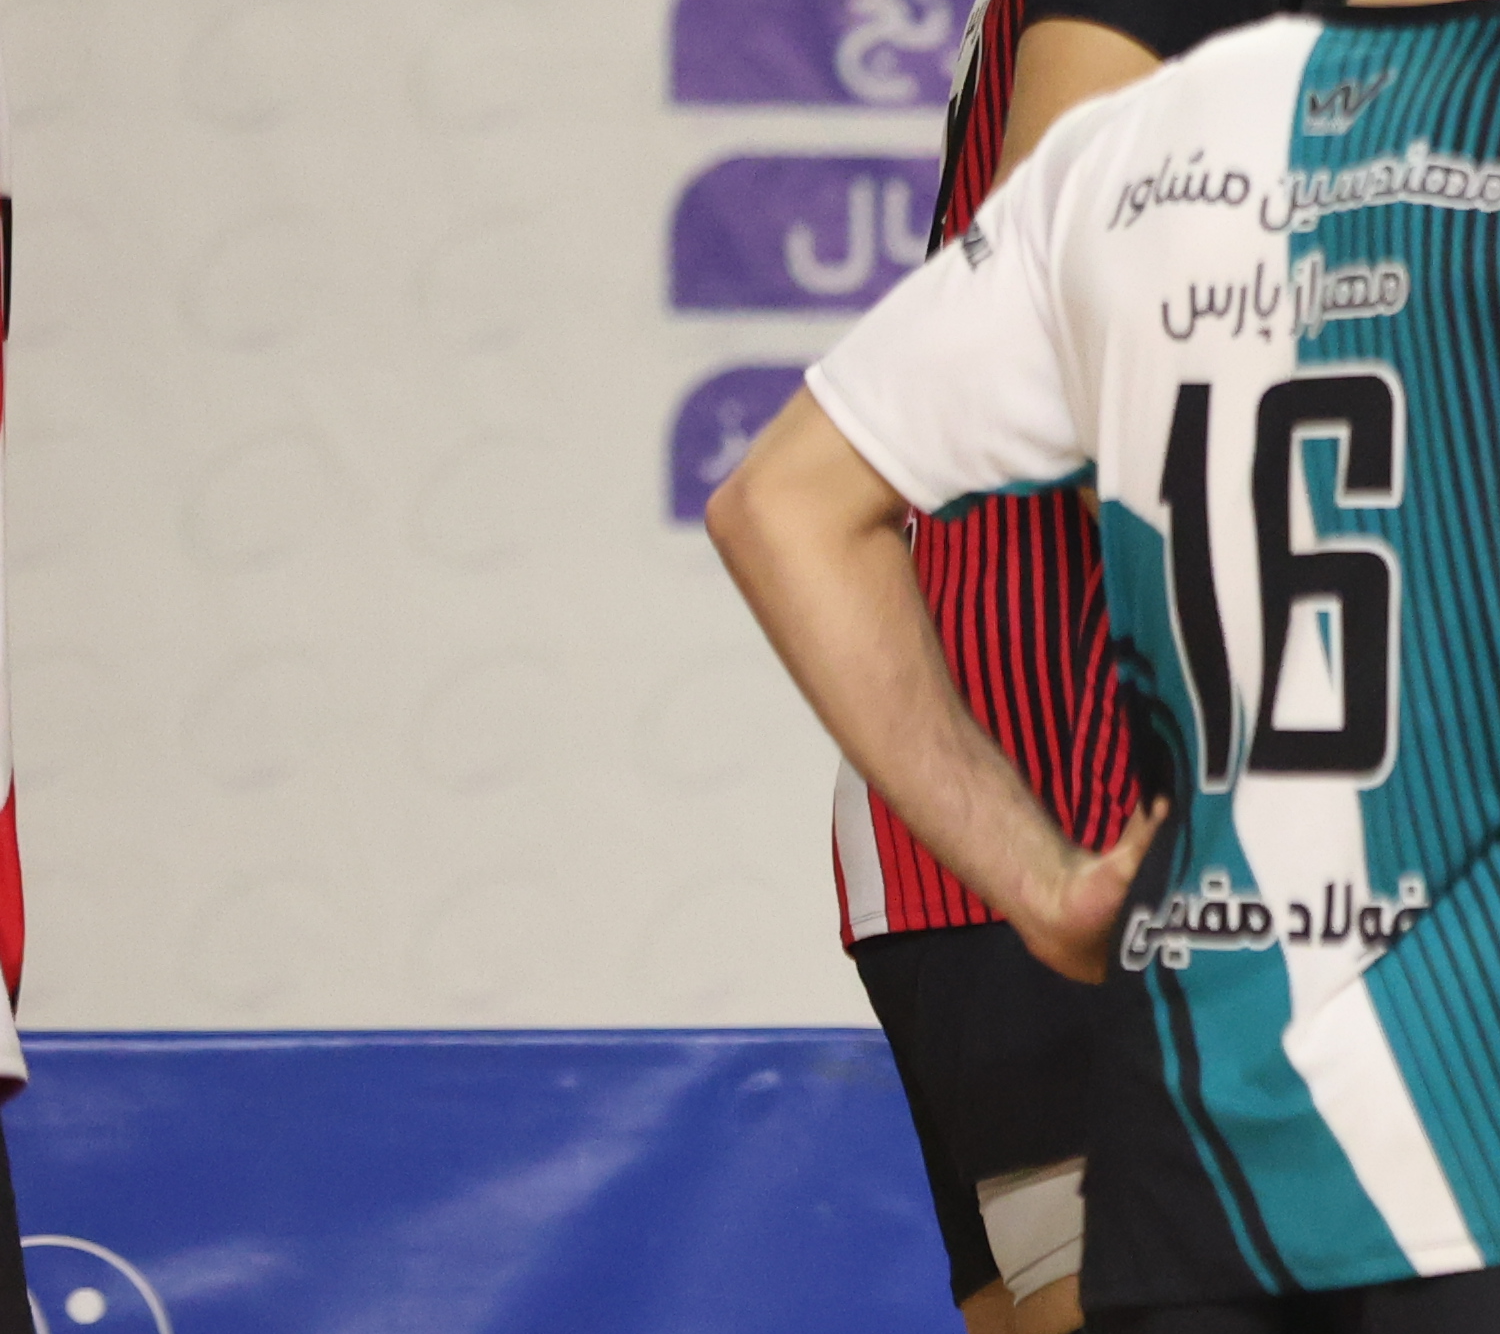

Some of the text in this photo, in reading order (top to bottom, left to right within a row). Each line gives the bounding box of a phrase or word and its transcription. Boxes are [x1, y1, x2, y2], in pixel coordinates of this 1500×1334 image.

[1106, 148, 1251, 232] مشاور
[1160, 260, 1283, 342] پارس
[1156, 369, 1400, 791] 16
